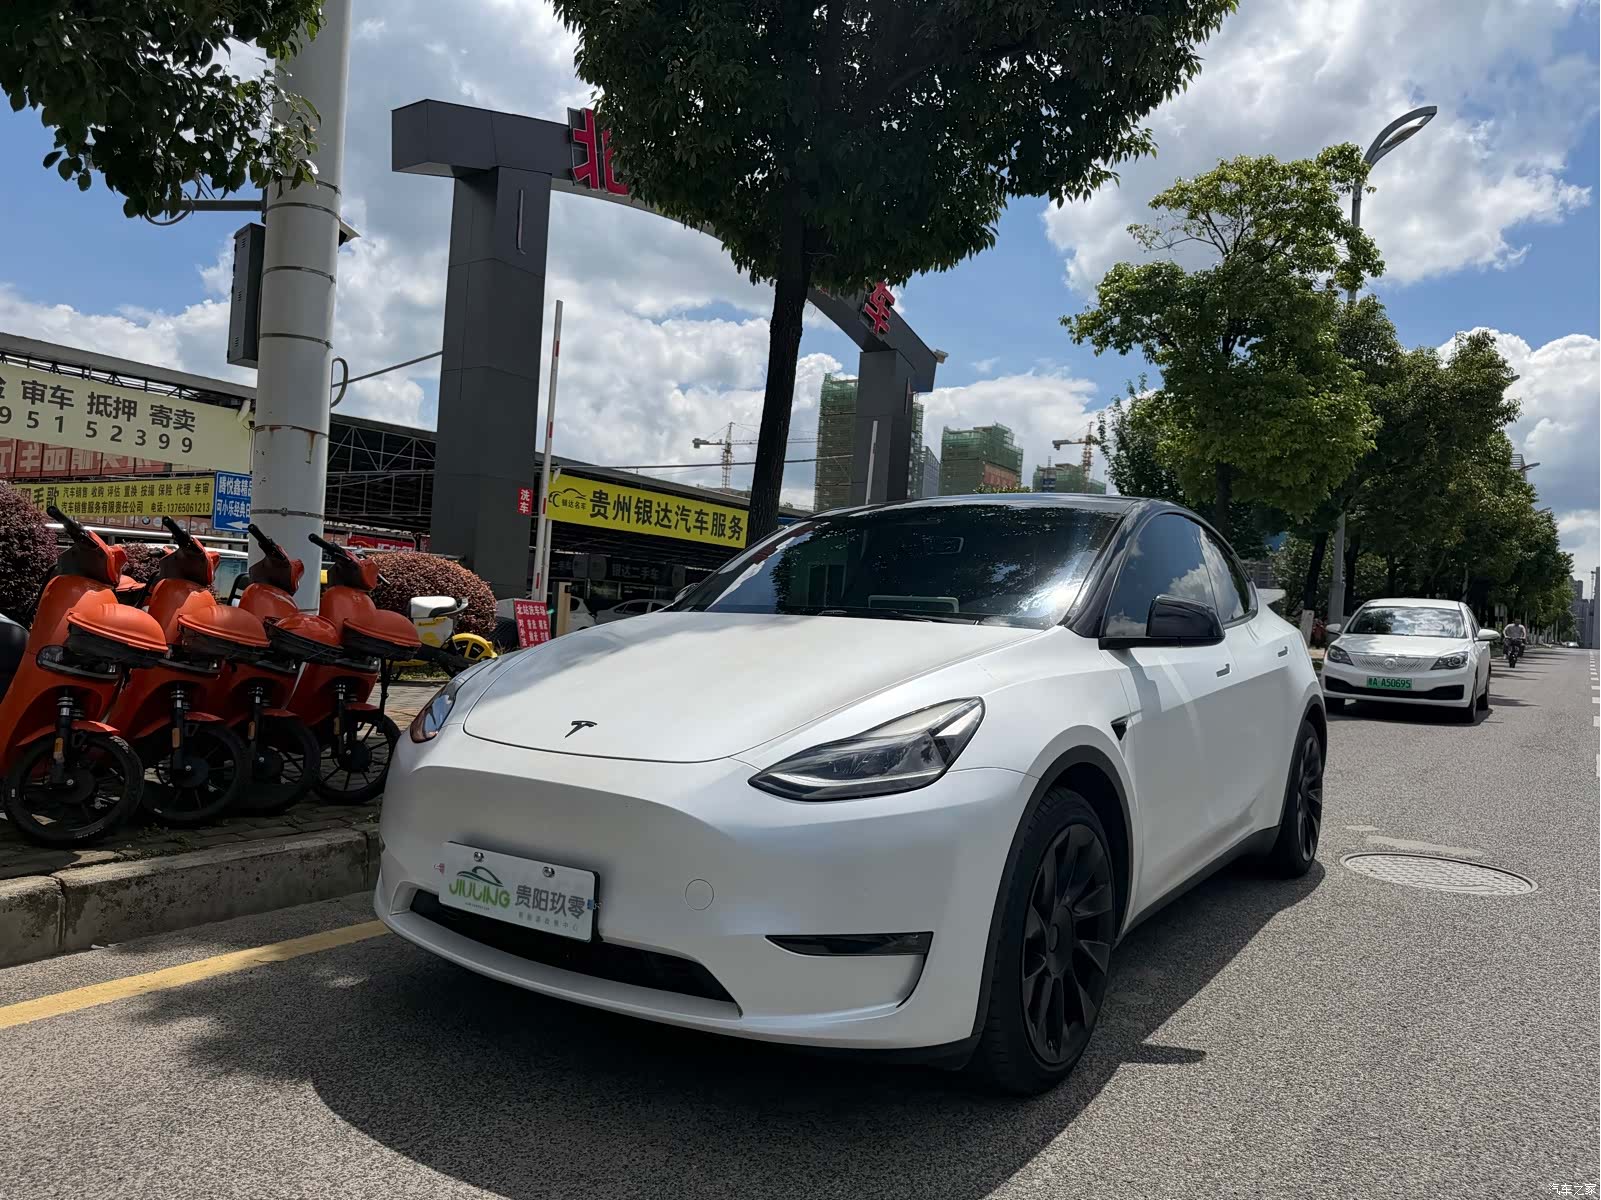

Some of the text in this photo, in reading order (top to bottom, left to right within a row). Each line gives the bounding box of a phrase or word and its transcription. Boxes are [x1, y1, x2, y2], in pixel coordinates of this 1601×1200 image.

[573, 107, 629, 195] 北
[864, 281, 895, 335] 车
[21, 379, 75, 411] 审车
[87, 391, 138, 422] 抵押
[149, 404, 196, 433] 寄卖
[158, 483, 173, 496] 保险
[176, 483, 191, 496] 代理
[194, 482, 210, 496] 年审
[519, 489, 530, 513] 洗车
[589, 489, 744, 541] 贵州银达汽车服务
[515, 884, 586, 920] 贵阳玖零
